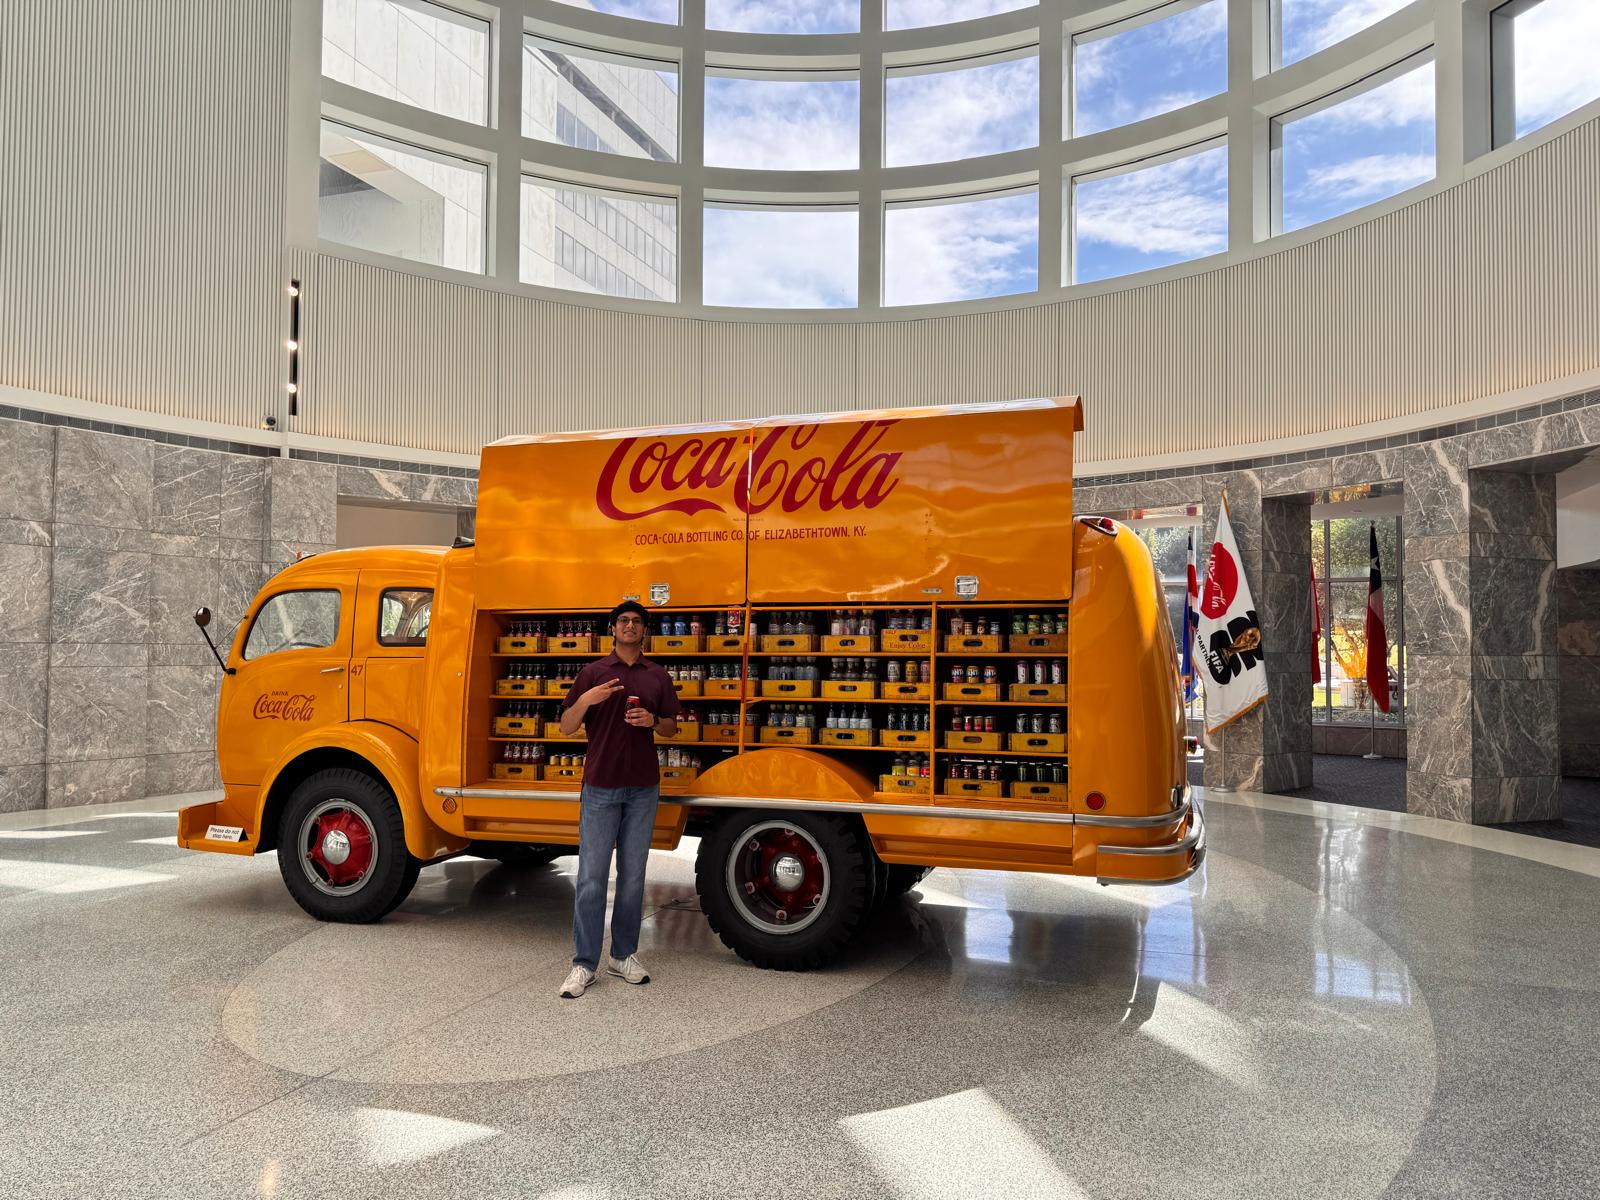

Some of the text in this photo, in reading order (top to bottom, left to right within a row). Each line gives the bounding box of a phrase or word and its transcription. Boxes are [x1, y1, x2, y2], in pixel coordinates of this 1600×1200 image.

[635, 533, 684, 546] COCA-COLA
[686, 531, 728, 543] BOTTLING
[731, 530, 744, 541] CO.
[748, 530, 760, 540] OF
[853, 525, 867, 537] KY.
[1198, 635, 1211, 668] PARTNE
[1209, 650, 1224, 674] FIFA
[350, 665, 364, 676] 47
[253, 693, 316, 721] Coca-Cola
